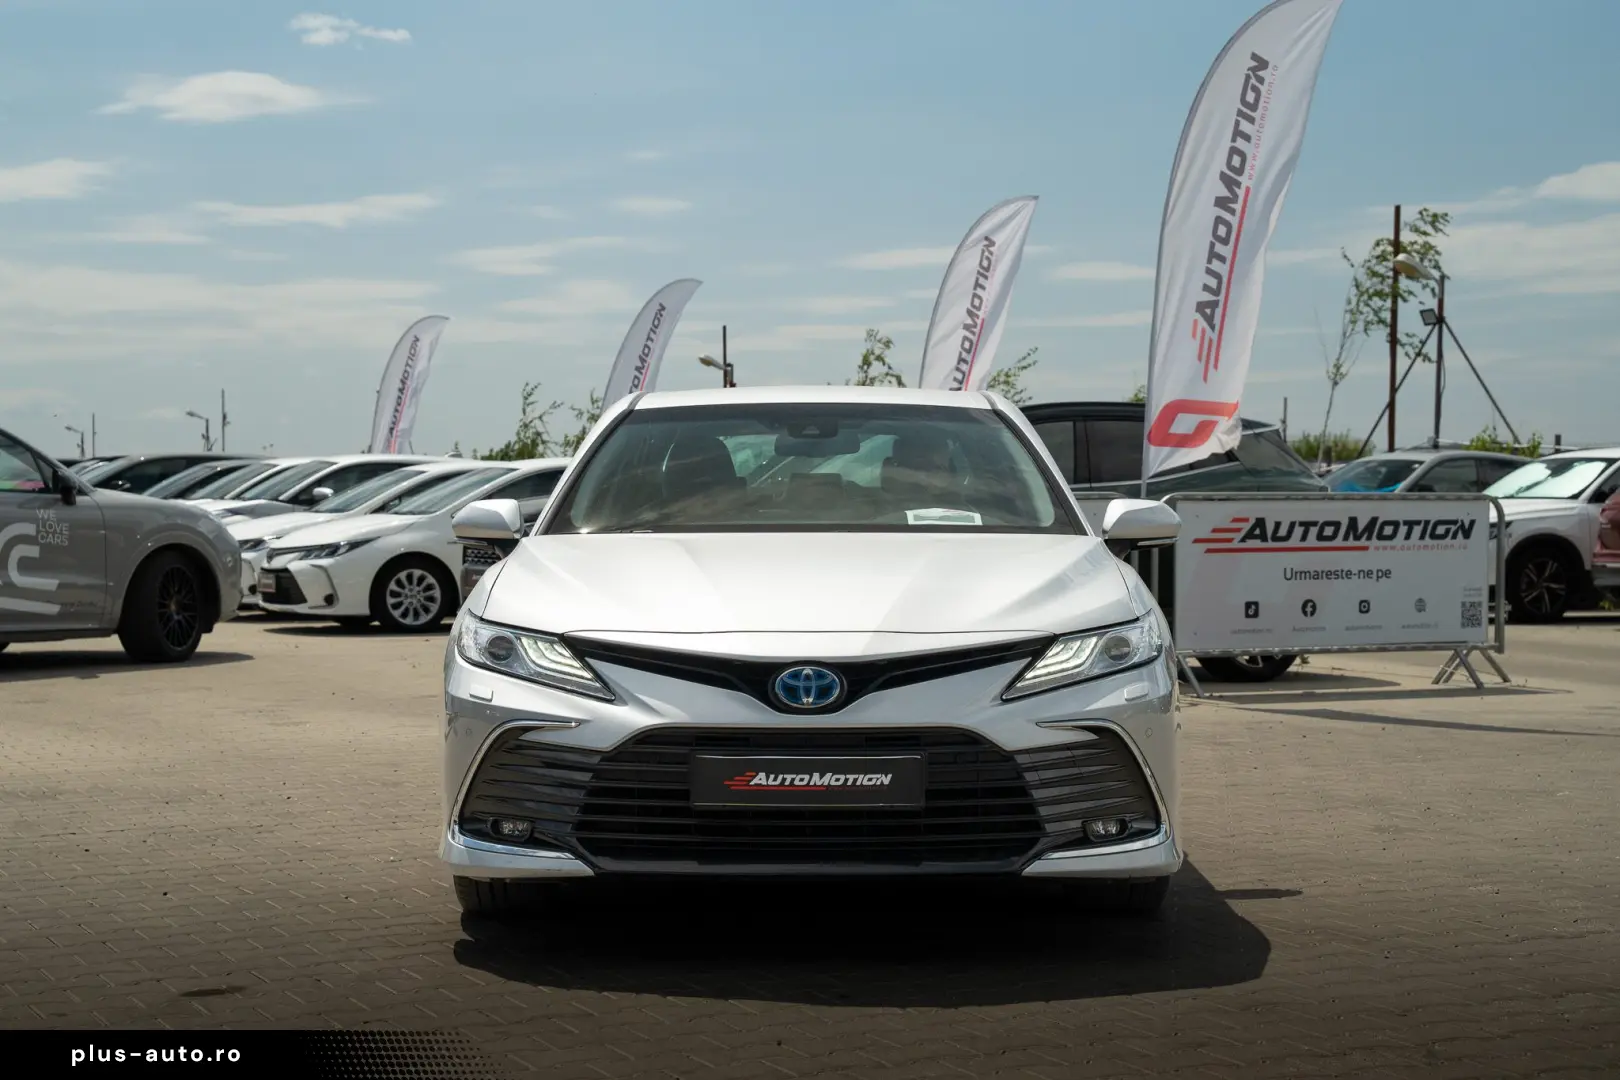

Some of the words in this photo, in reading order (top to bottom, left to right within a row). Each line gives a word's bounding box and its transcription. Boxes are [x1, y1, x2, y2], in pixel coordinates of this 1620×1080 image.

[36, 507, 58, 520] WE
[39, 519, 69, 535] LOVE
[38, 531, 69, 546] CARS
[1283, 567, 1374, 582] Urmareste-ne
[1376, 570, 1392, 583] pe
